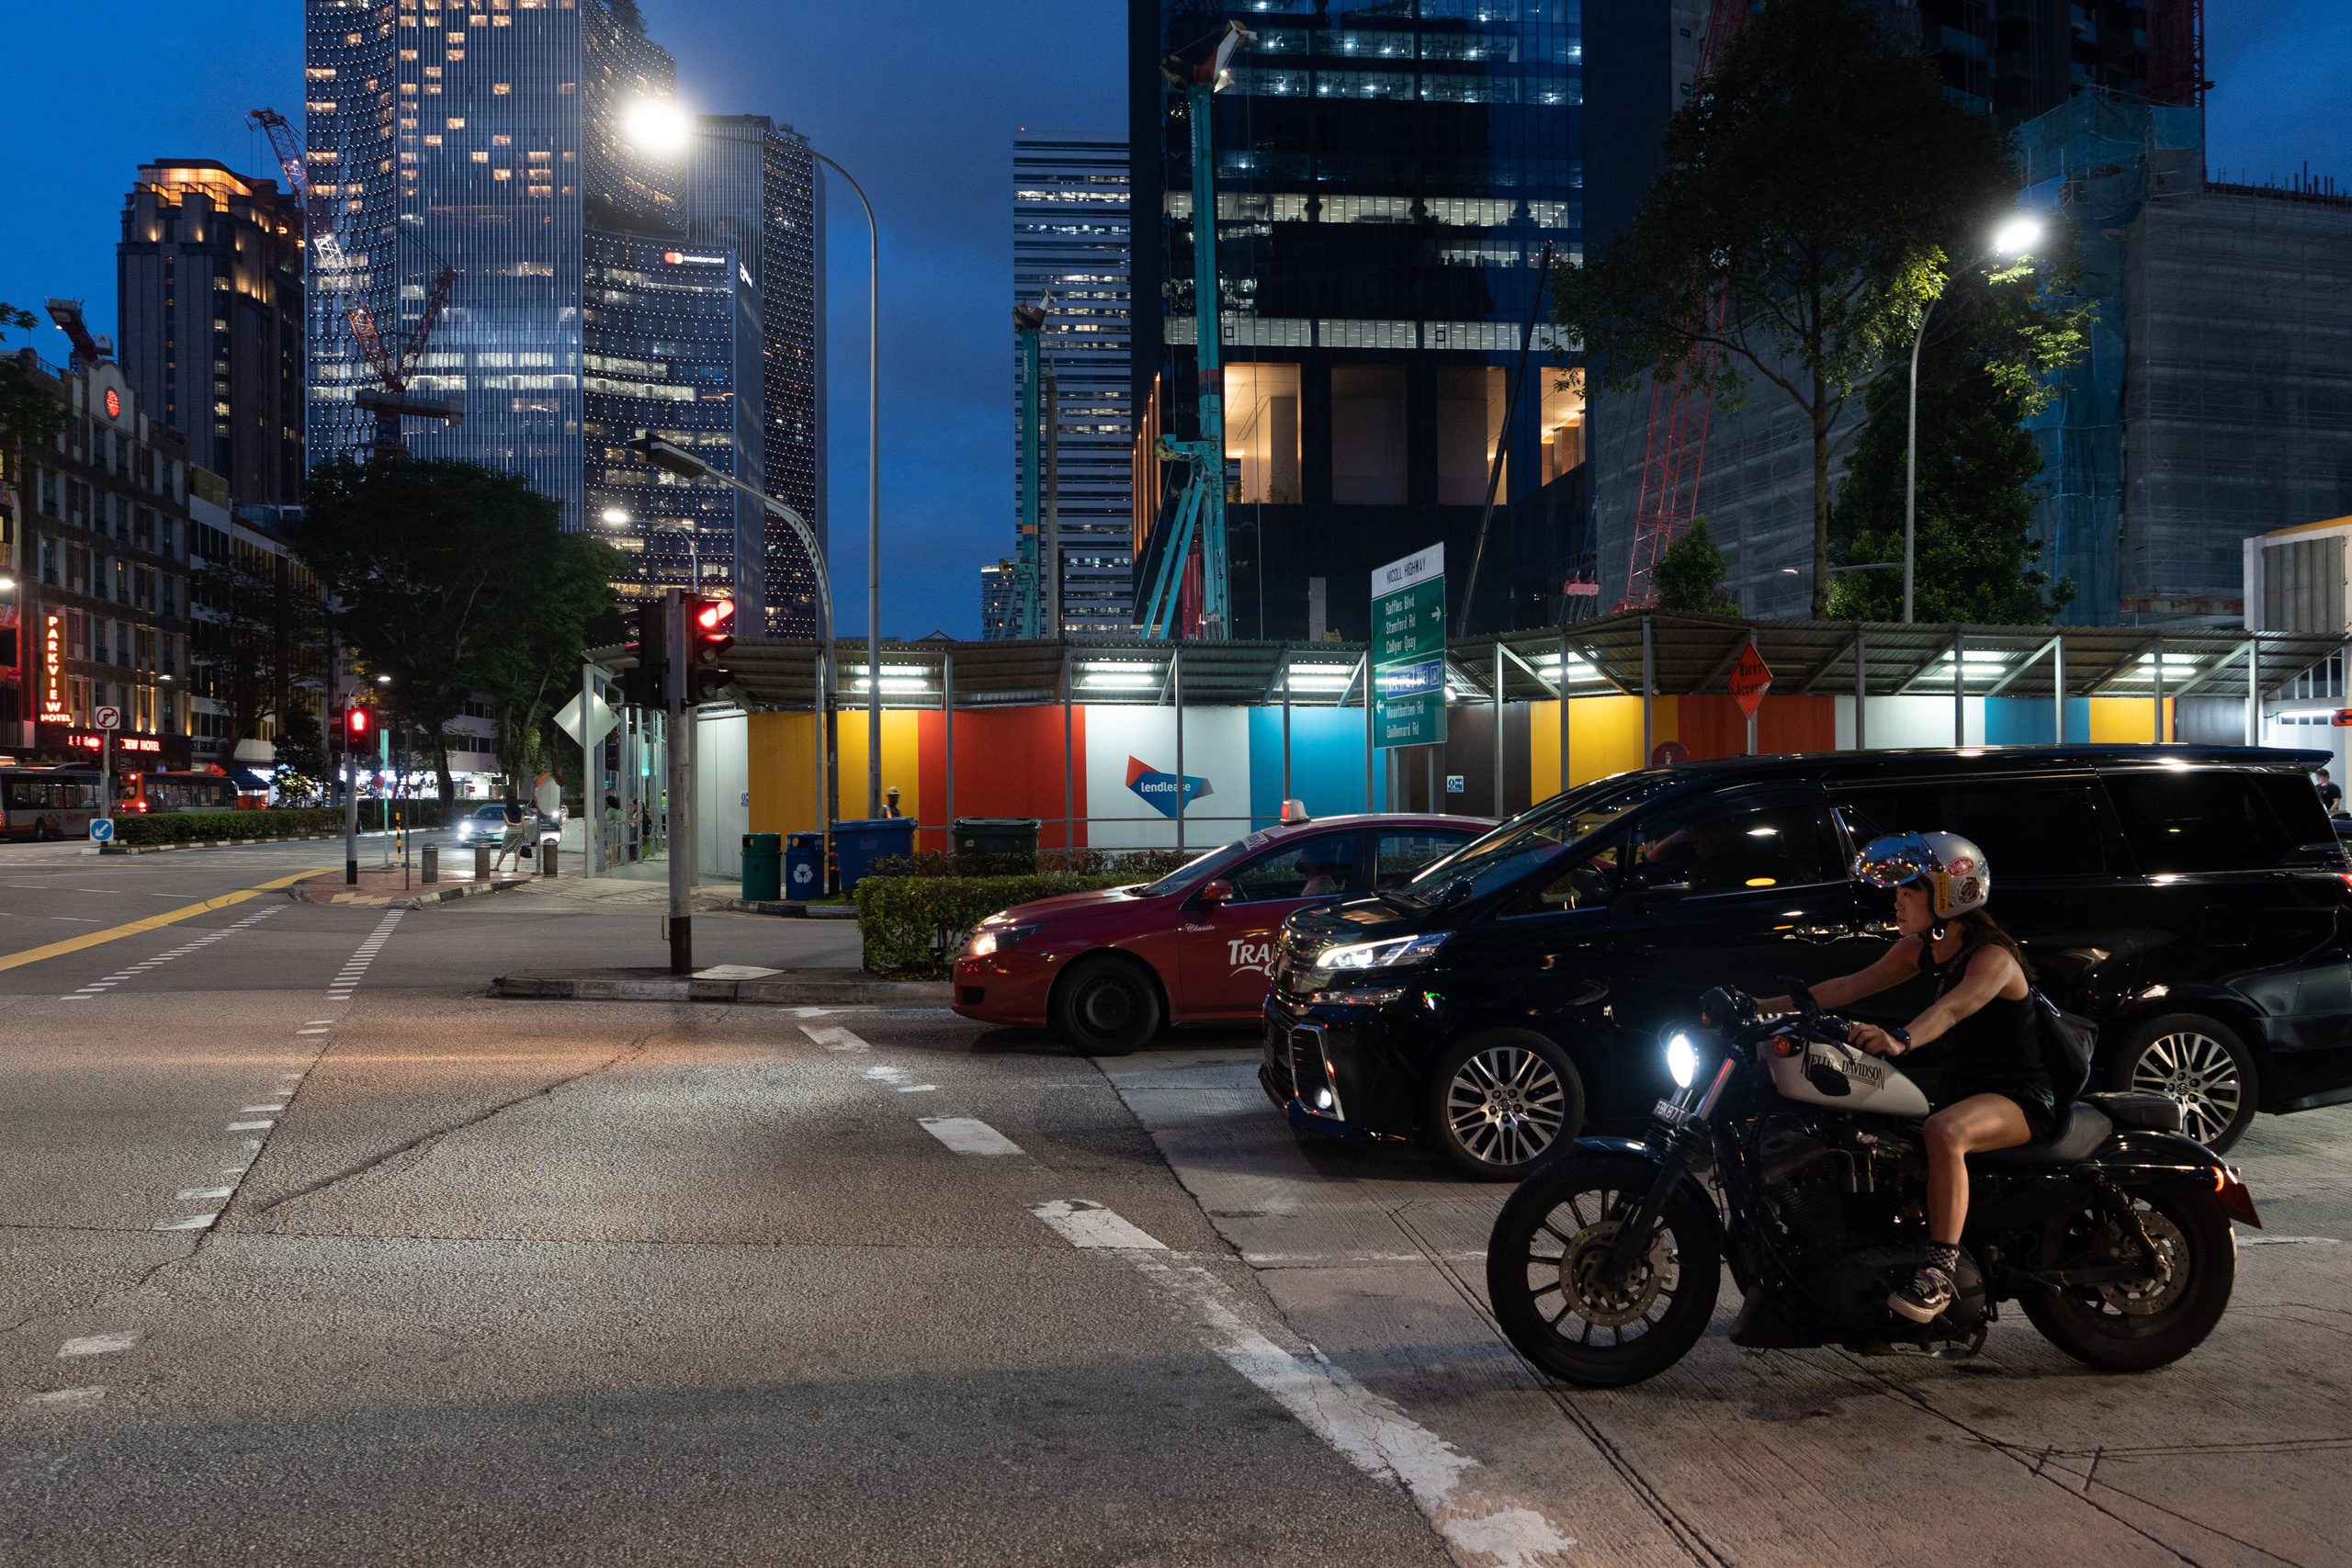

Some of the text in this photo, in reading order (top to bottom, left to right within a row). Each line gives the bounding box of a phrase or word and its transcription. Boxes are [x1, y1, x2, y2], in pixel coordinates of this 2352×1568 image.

[684, 255, 725, 265] mastercard
[1386, 557, 1426, 584] NICOLL HIGHWAY
[1385, 593, 1415, 615] Raffles Blvd
[1385, 613, 1416, 635] Stamford Rd
[1385, 635, 1417, 655] Collyer Quay
[45, 616, 62, 713] PARKVIEW
[1738, 662, 1762, 677] Works
[1736, 682, 1763, 695] Access
[40, 714, 73, 723] HOTEL
[1385, 700, 1424, 719] Mountbatten Rd
[1386, 721, 1419, 739] Guillemard Rd
[140, 739, 161, 752] HOTEL
[1185, 923, 1216, 933] Classic
[1654, 1100, 1686, 1123] FBK87T
